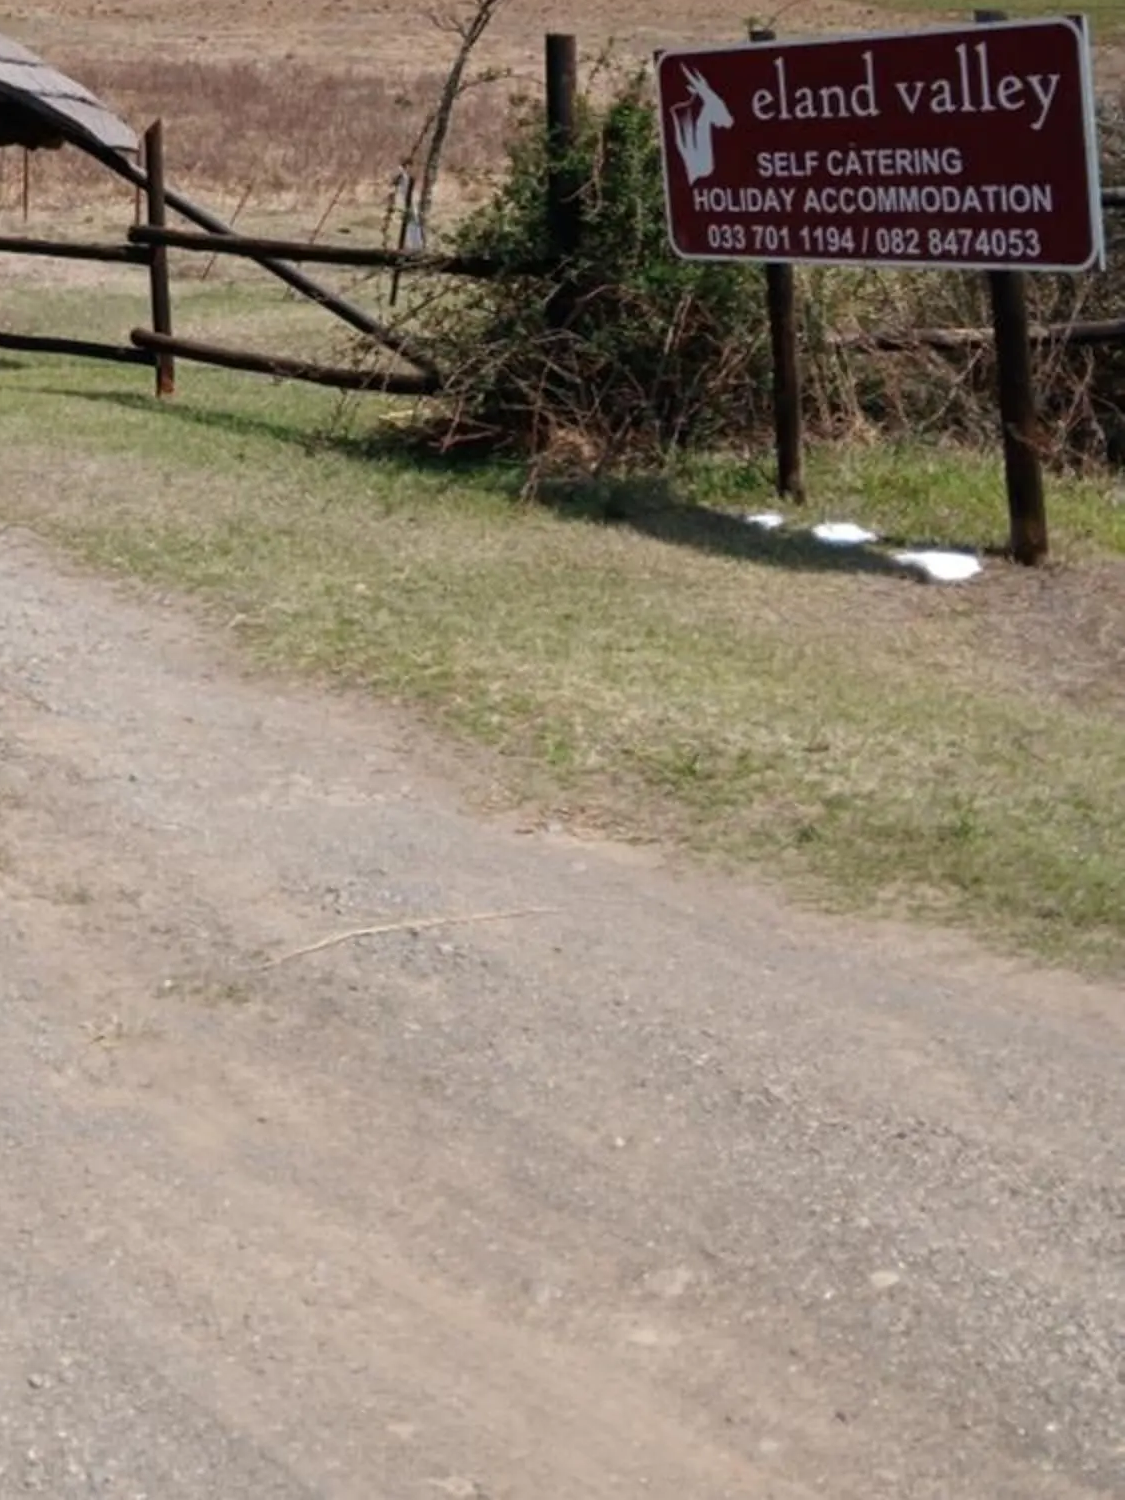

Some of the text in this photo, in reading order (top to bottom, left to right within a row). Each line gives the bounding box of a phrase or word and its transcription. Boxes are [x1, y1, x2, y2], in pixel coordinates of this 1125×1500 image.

[751, 42, 1061, 130] eland valley
[757, 147, 963, 178] SELF CATERING
[693, 185, 1053, 213] HOLIDAY ACCOMMODATION
[707, 224, 1041, 257] 033 701 1194 / 082 8474053
